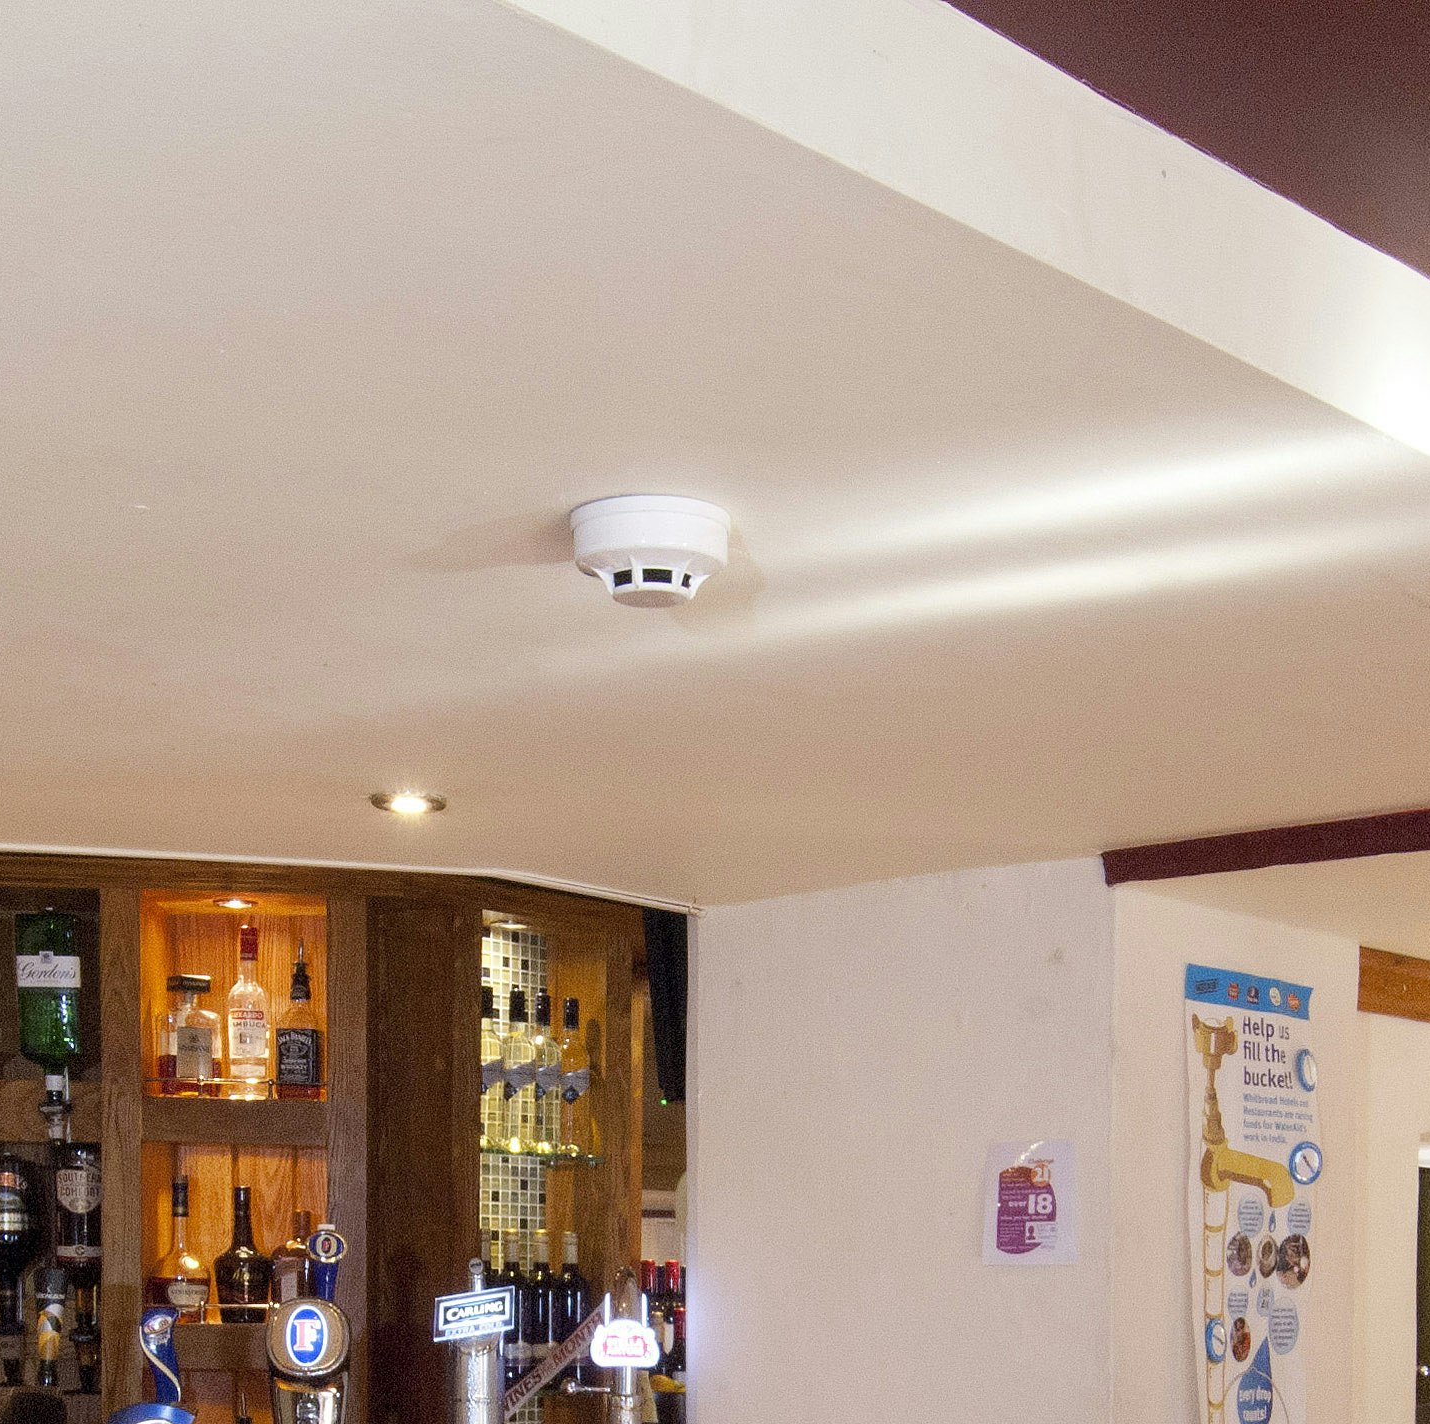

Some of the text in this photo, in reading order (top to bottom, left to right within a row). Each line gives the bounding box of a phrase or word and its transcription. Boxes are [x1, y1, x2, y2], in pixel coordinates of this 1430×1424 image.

[21, 961, 76, 980] Gordon's
[1242, 1016, 1290, 1041] Help us
[1243, 1041, 1286, 1064] fill the
[1243, 1066, 1293, 1089] bucket!
[1028, 1194, 1053, 1214] 18
[445, 1300, 504, 1320] CARLING
[293, 1319, 321, 1351] F
